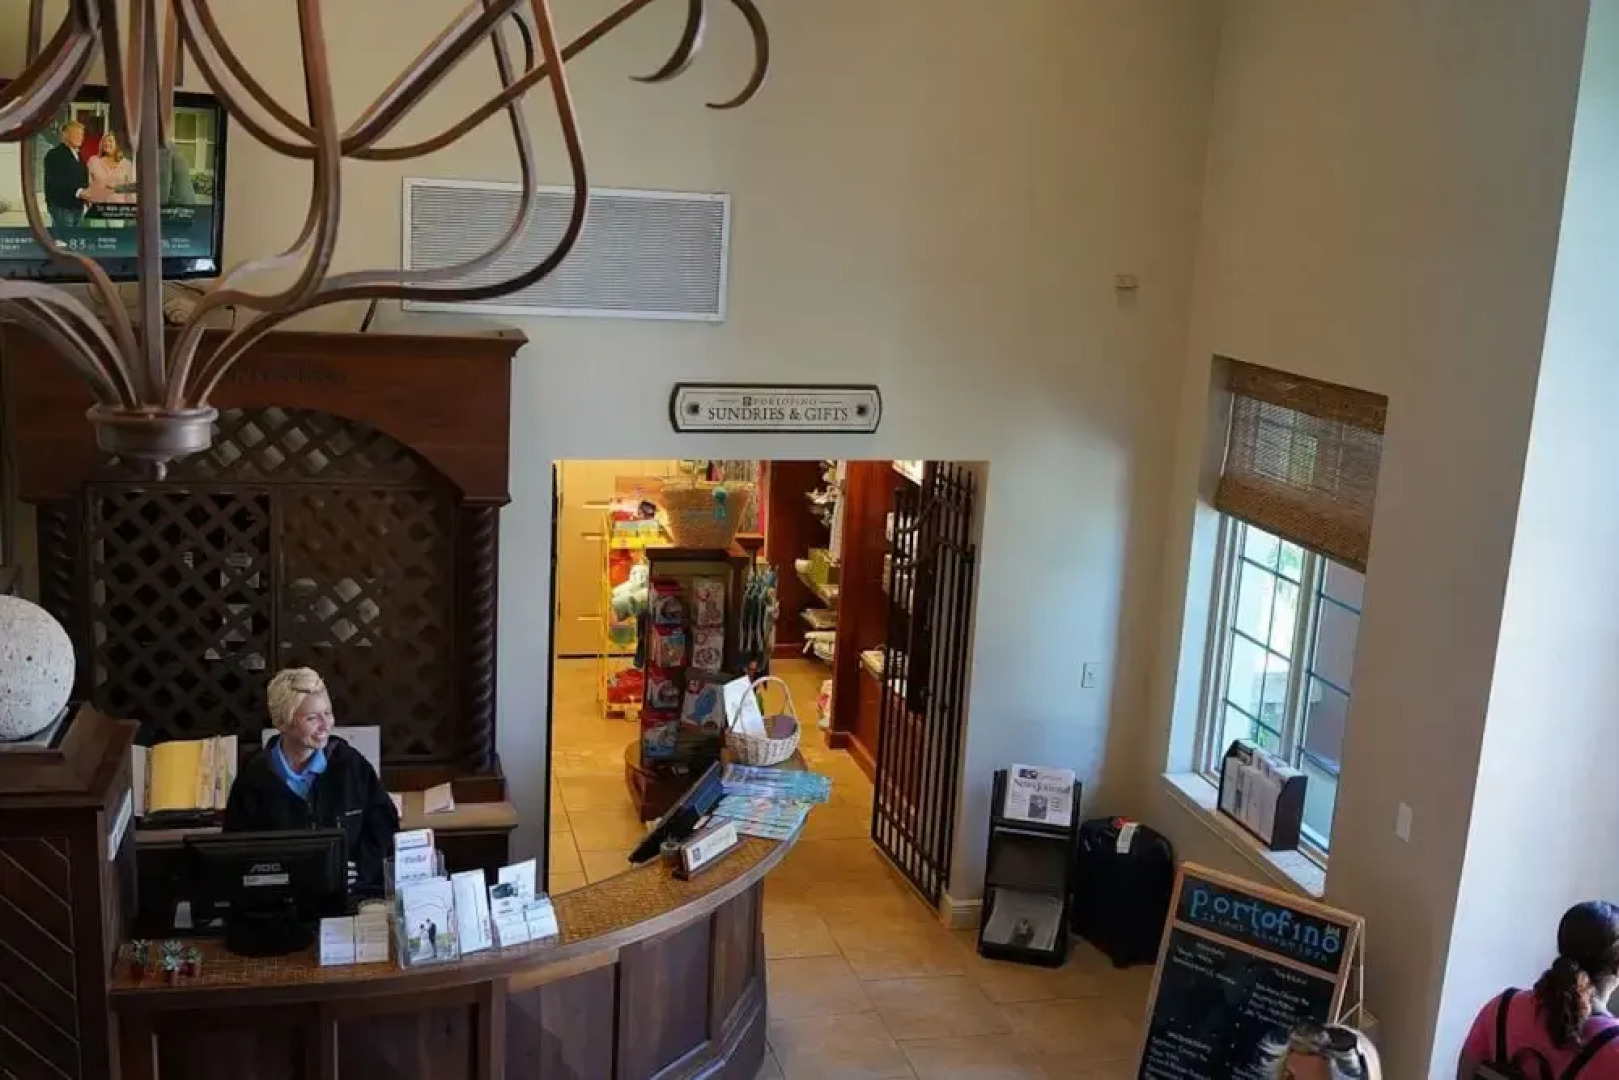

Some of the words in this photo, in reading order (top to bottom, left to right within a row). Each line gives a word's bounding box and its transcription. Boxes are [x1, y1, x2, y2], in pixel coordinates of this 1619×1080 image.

[753, 397, 817, 406] PORTOFINO
[708, 407, 786, 421] SUNDRIES
[789, 408, 801, 421] &
[805, 408, 848, 422] GIFTS
